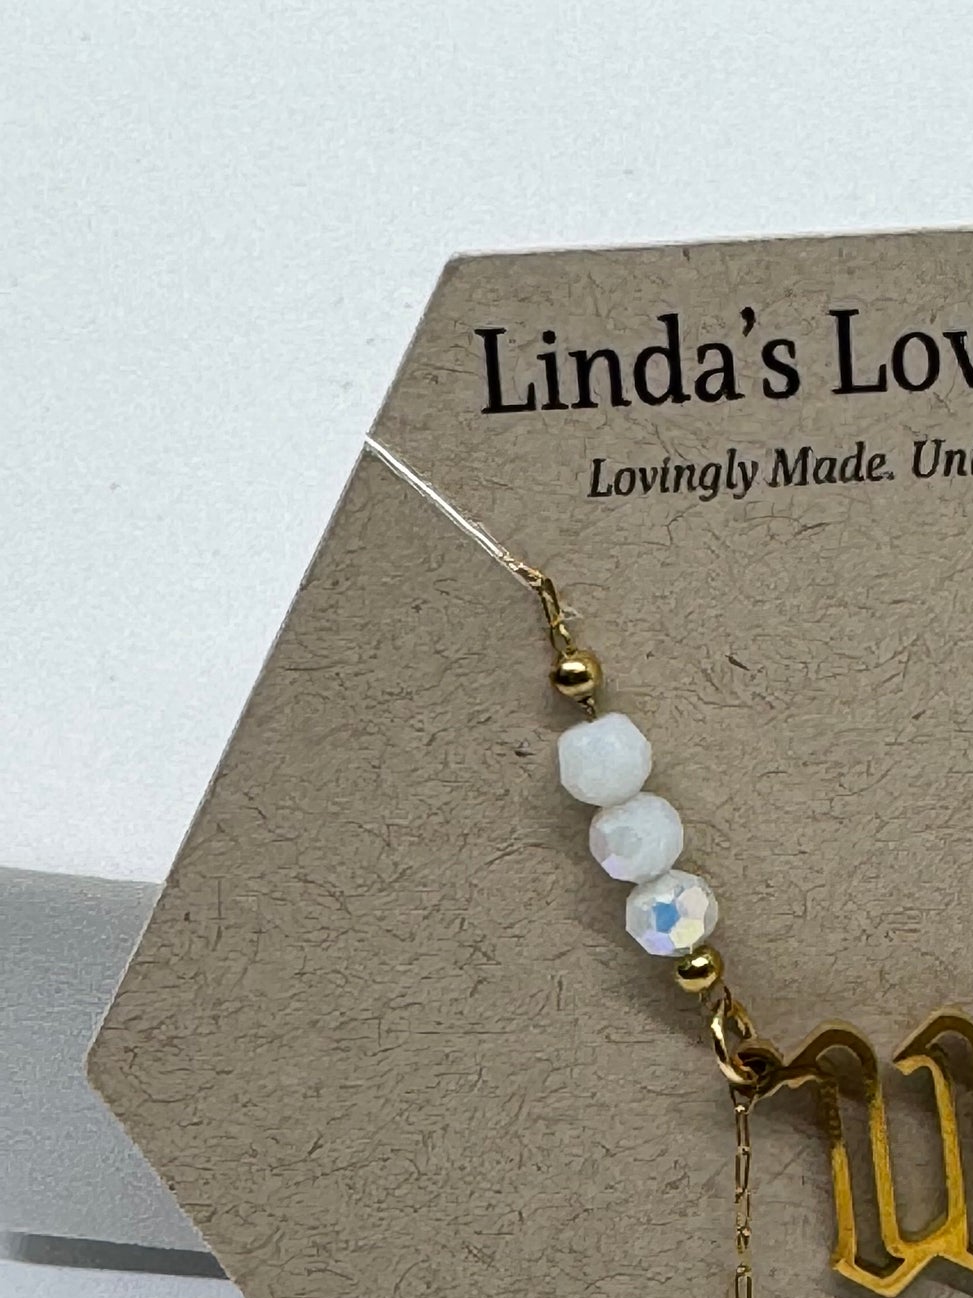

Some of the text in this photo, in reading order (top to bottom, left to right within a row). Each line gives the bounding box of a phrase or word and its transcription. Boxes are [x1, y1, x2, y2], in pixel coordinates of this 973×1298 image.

[474, 307, 801, 415] Linda’s
[588, 449, 758, 502] Lovingly
[767, 441, 895, 488] Made.
